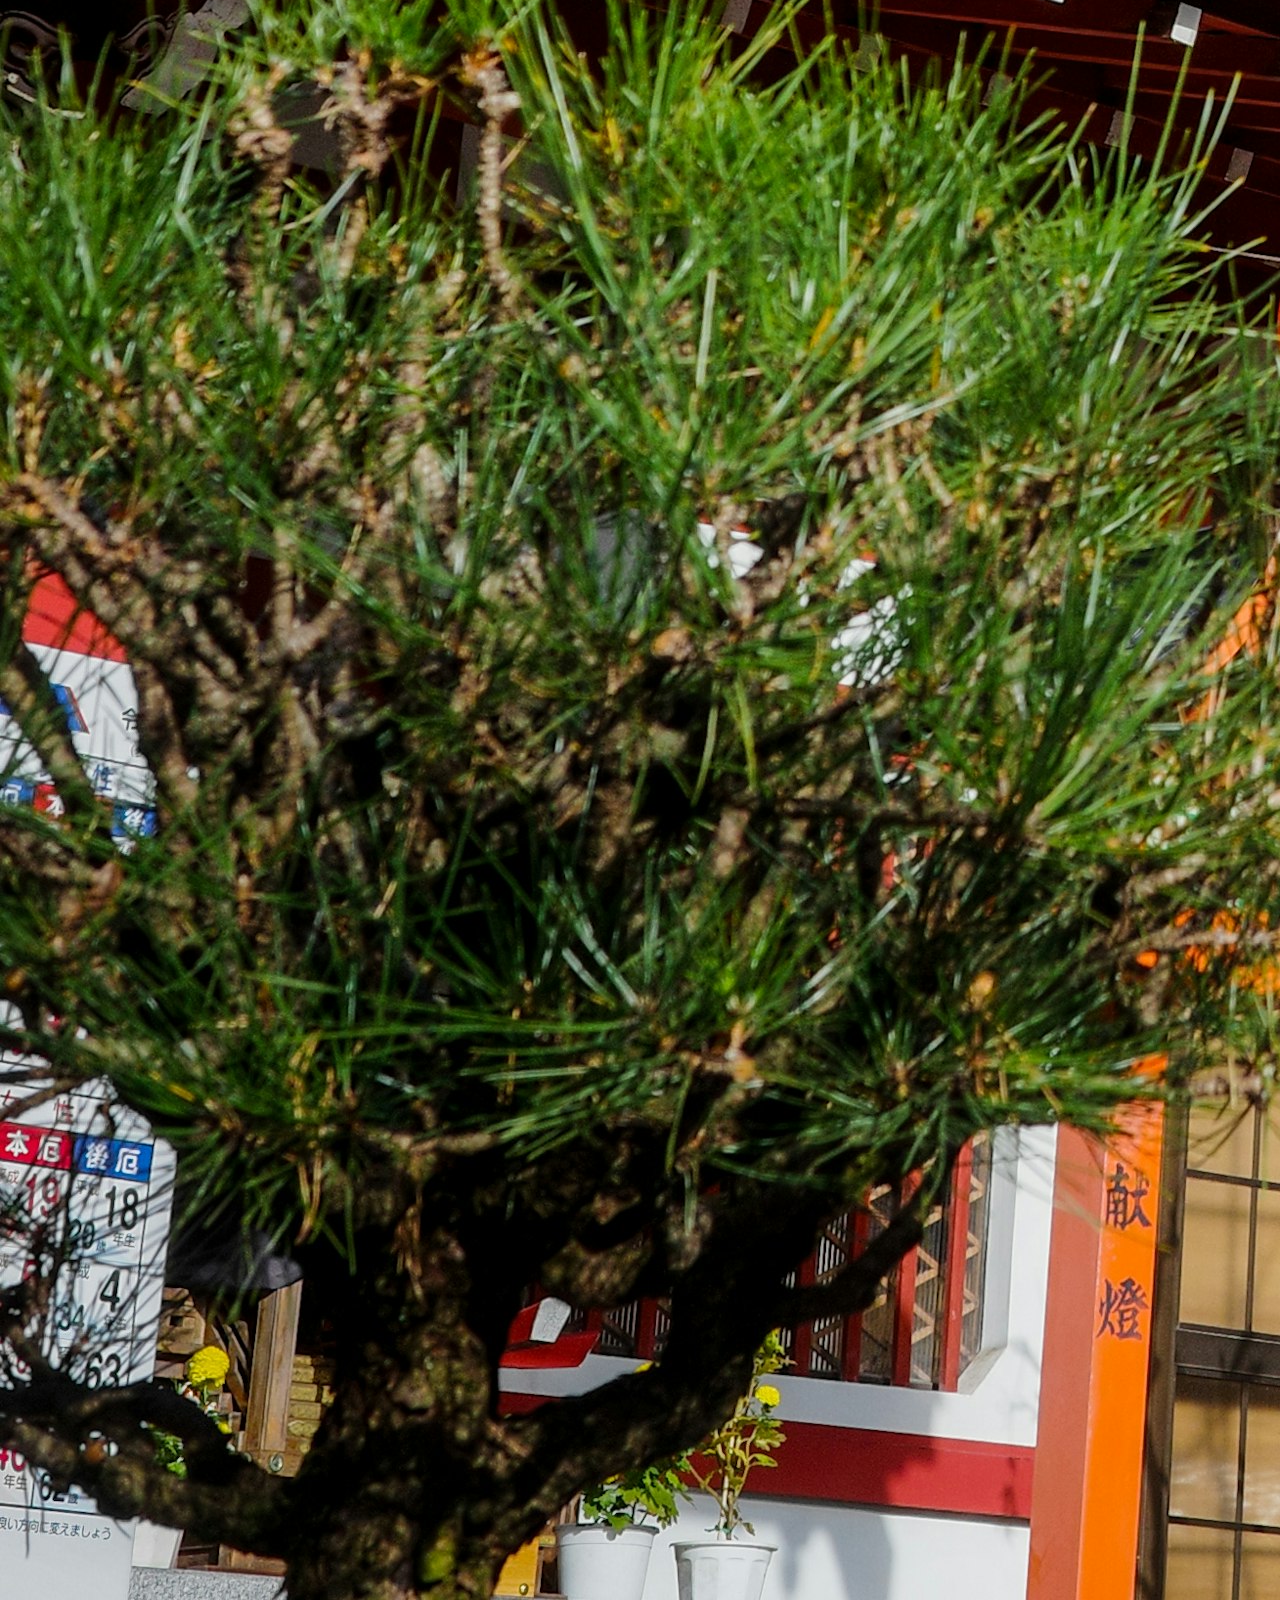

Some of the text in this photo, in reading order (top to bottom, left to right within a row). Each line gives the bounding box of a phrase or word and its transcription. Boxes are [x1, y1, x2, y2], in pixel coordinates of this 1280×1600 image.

[5, 1129, 141, 1175] 本厄 後厄
[105, 1186, 138, 1230] 18
[113, 1232, 136, 1248] 年生
[1096, 1162, 1152, 1341] 献燈
[100, 1270, 120, 1313] 4
[4, 1474, 27, 1491] 年生
